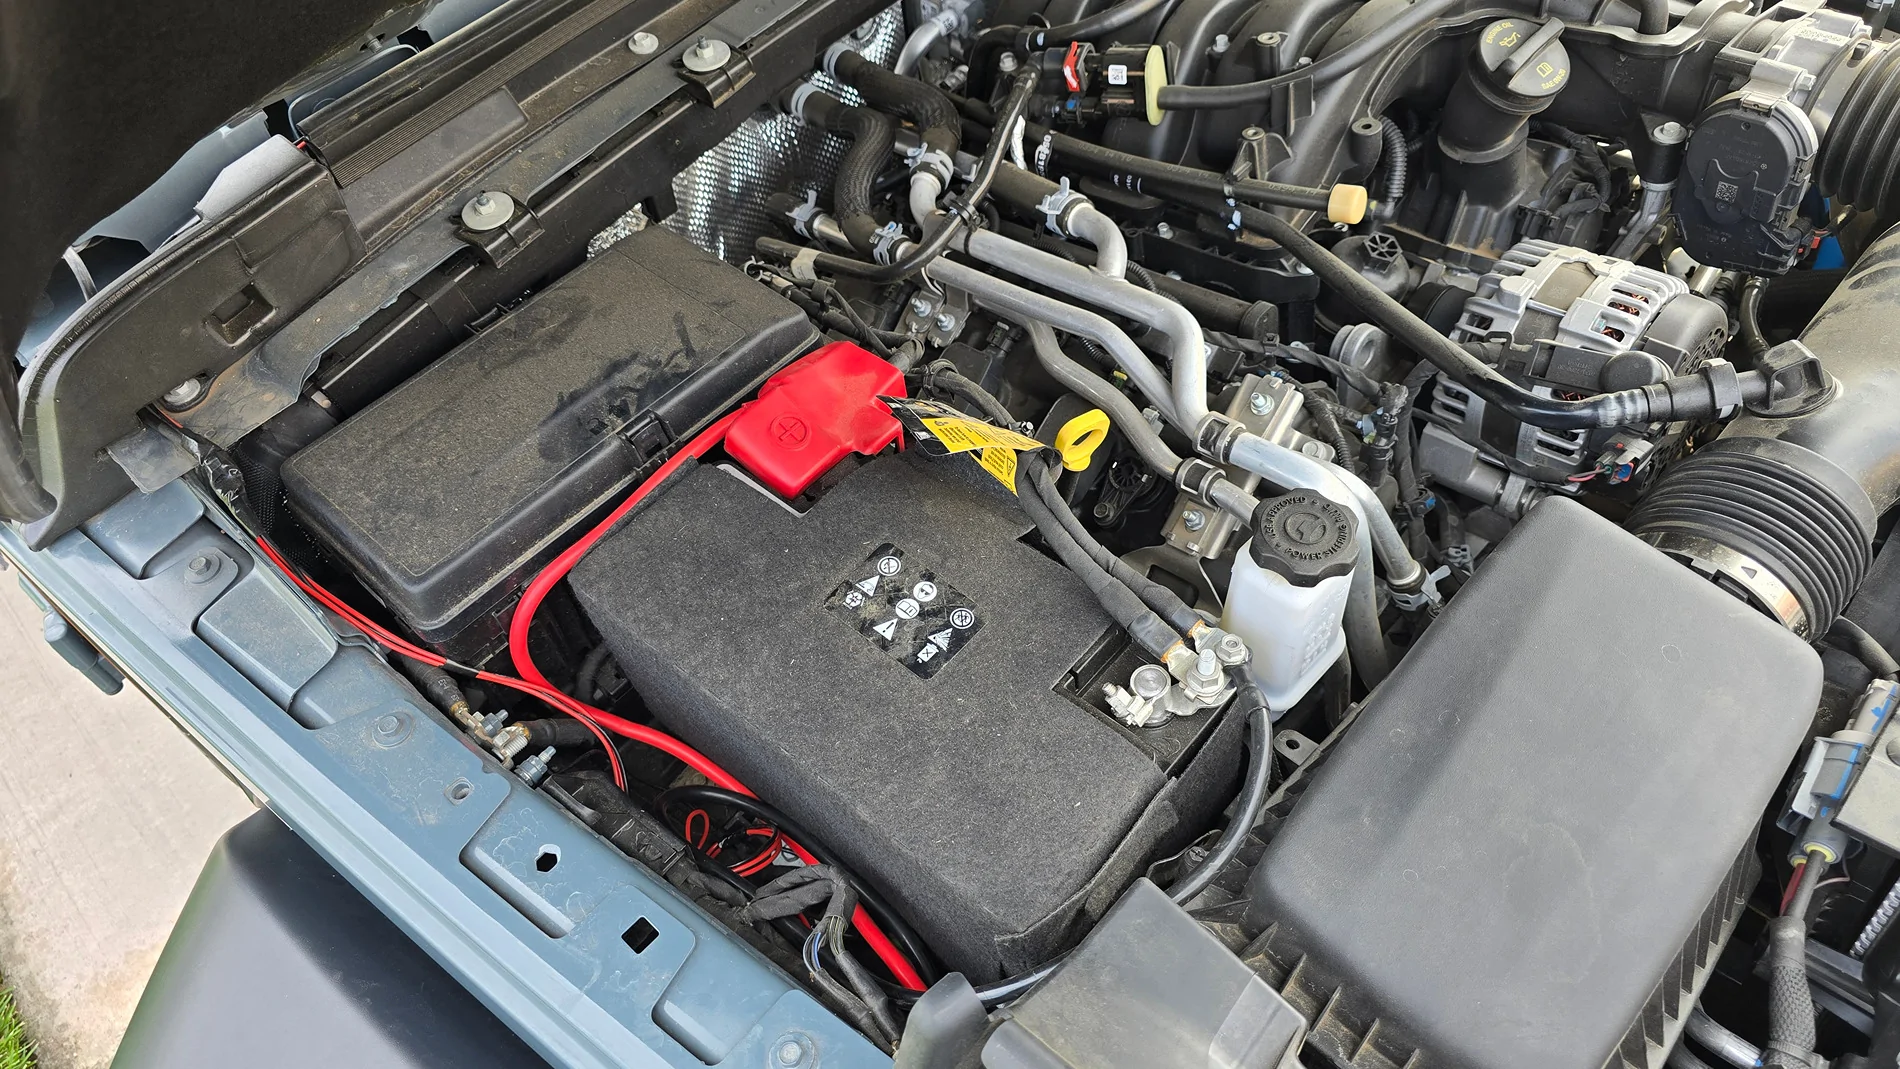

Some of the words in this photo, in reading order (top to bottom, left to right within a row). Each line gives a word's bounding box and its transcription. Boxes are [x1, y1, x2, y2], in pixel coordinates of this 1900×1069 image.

[1486, 25, 1503, 44] ENGINE
[1541, 80, 1555, 89] SAE
[1265, 496, 1306, 523] APPROVED
[1264, 524, 1276, 539] USE
[1285, 547, 1323, 561] POWER
[1324, 524, 1348, 557] STEERING
